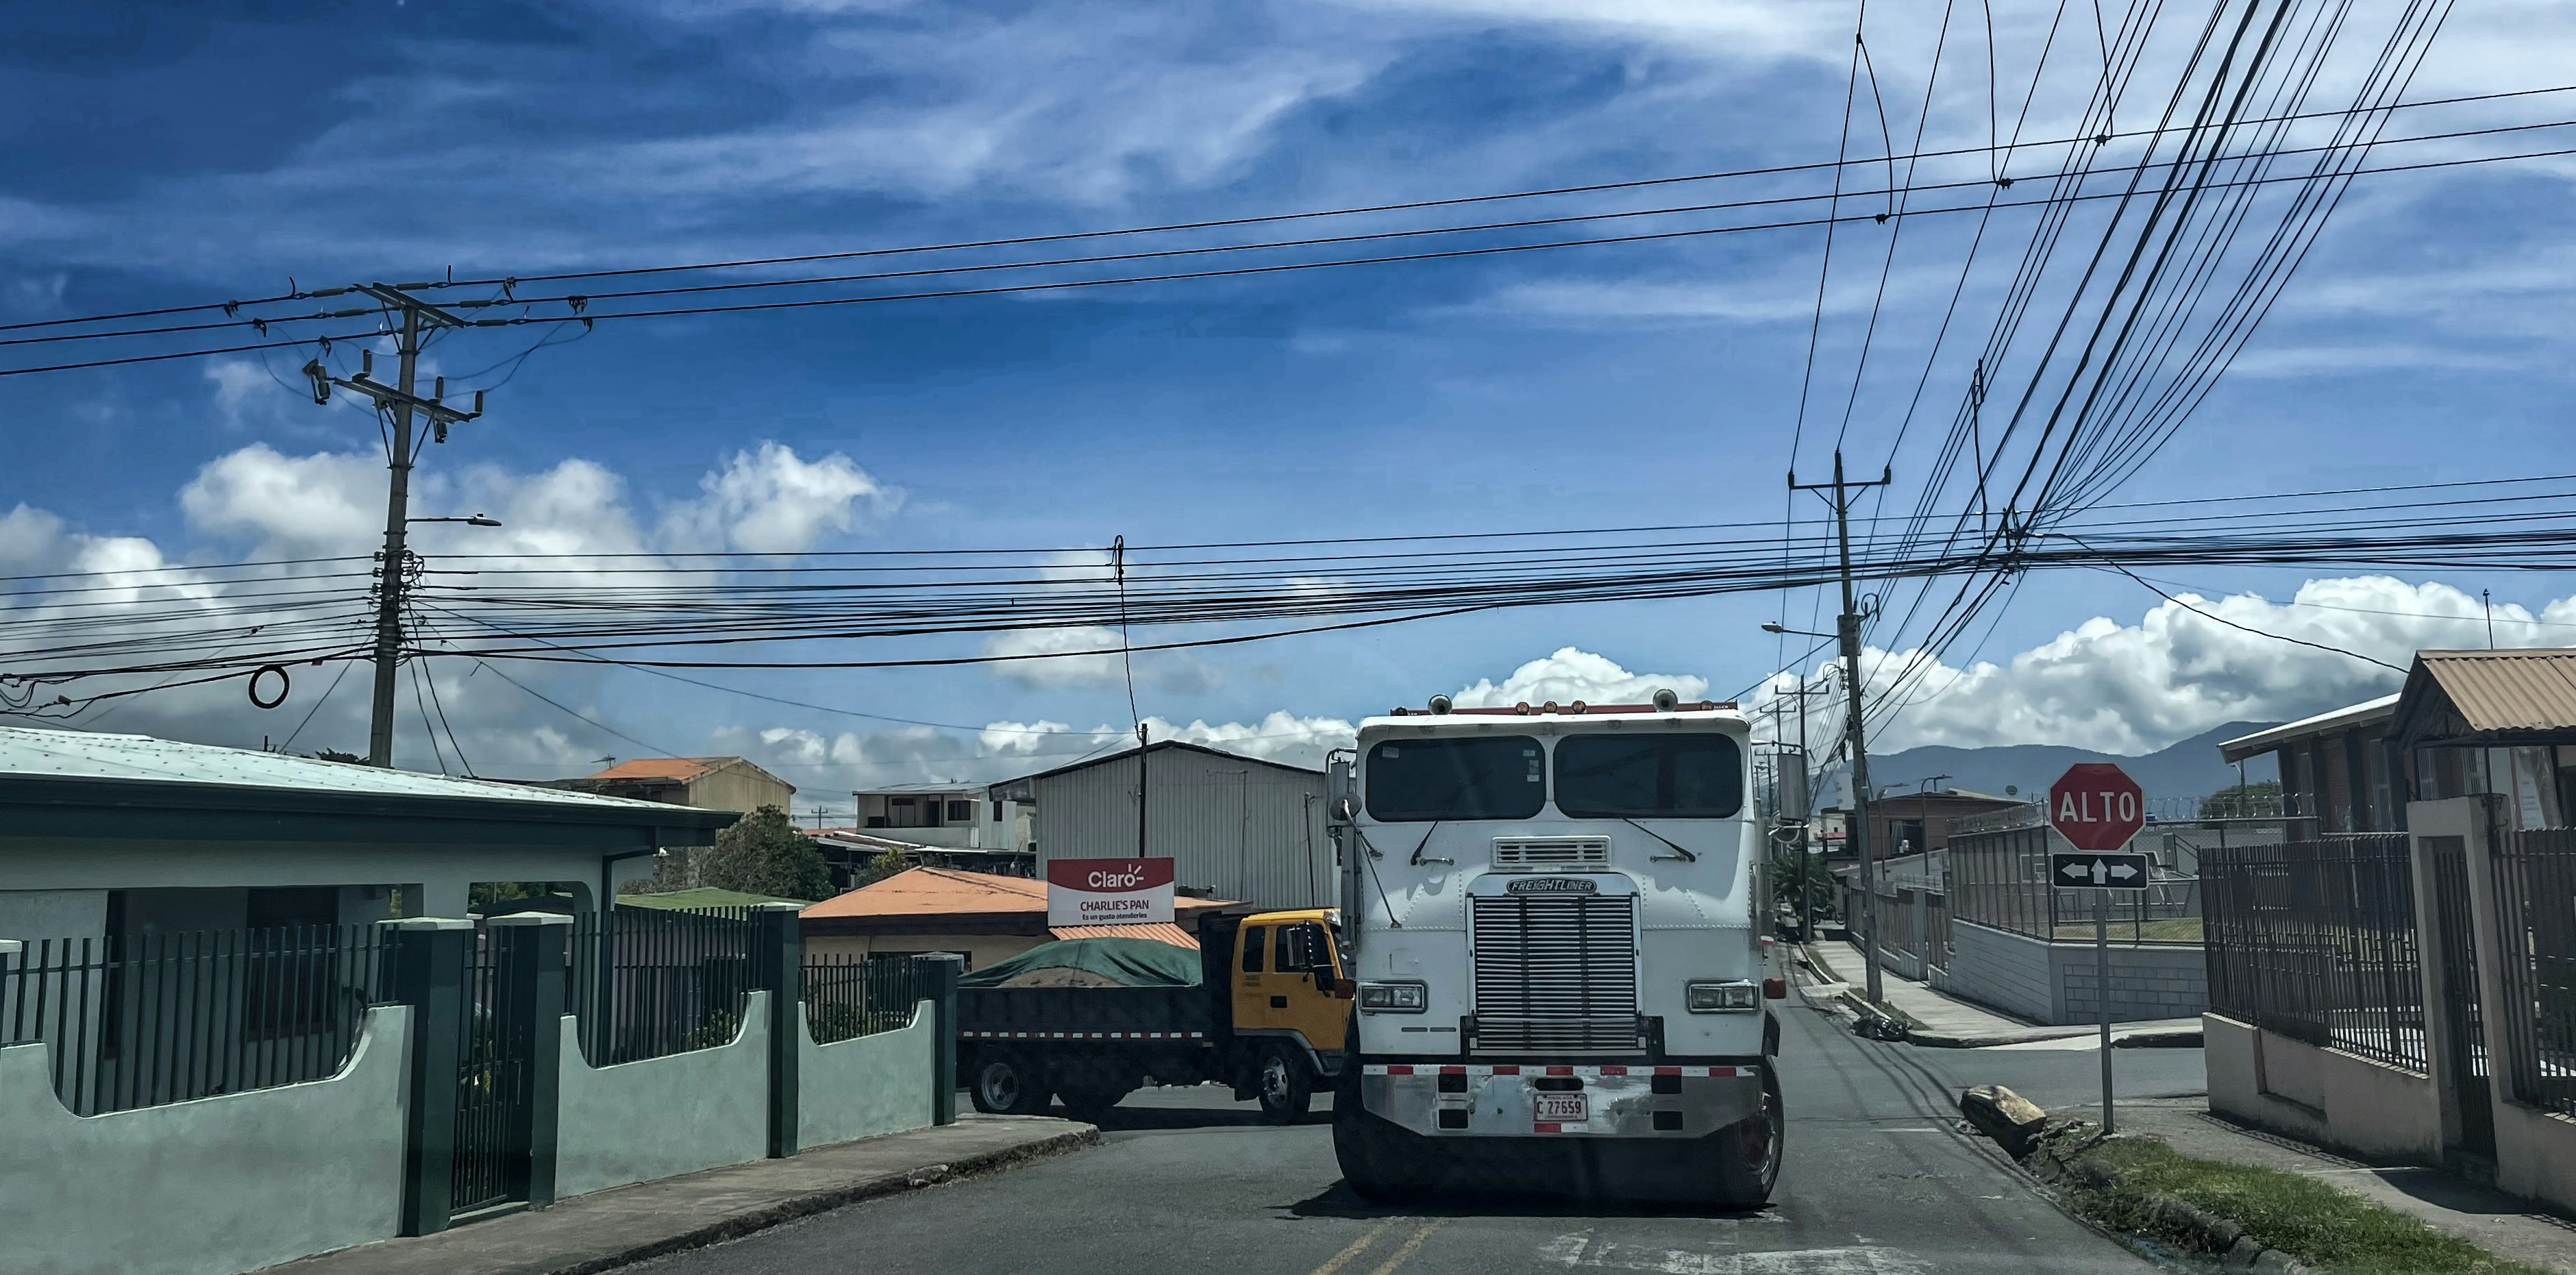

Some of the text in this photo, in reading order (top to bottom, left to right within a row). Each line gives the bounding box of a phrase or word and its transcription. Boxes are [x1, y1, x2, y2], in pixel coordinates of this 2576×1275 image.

[2059, 791, 2135, 823] ALTO
[1088, 870, 1137, 888] Claro
[1511, 879, 1592, 891] FREIGHTLINER
[1080, 900, 1149, 912] CHARLIE'S PAN
[1537, 1100, 1581, 1115] C 27659
